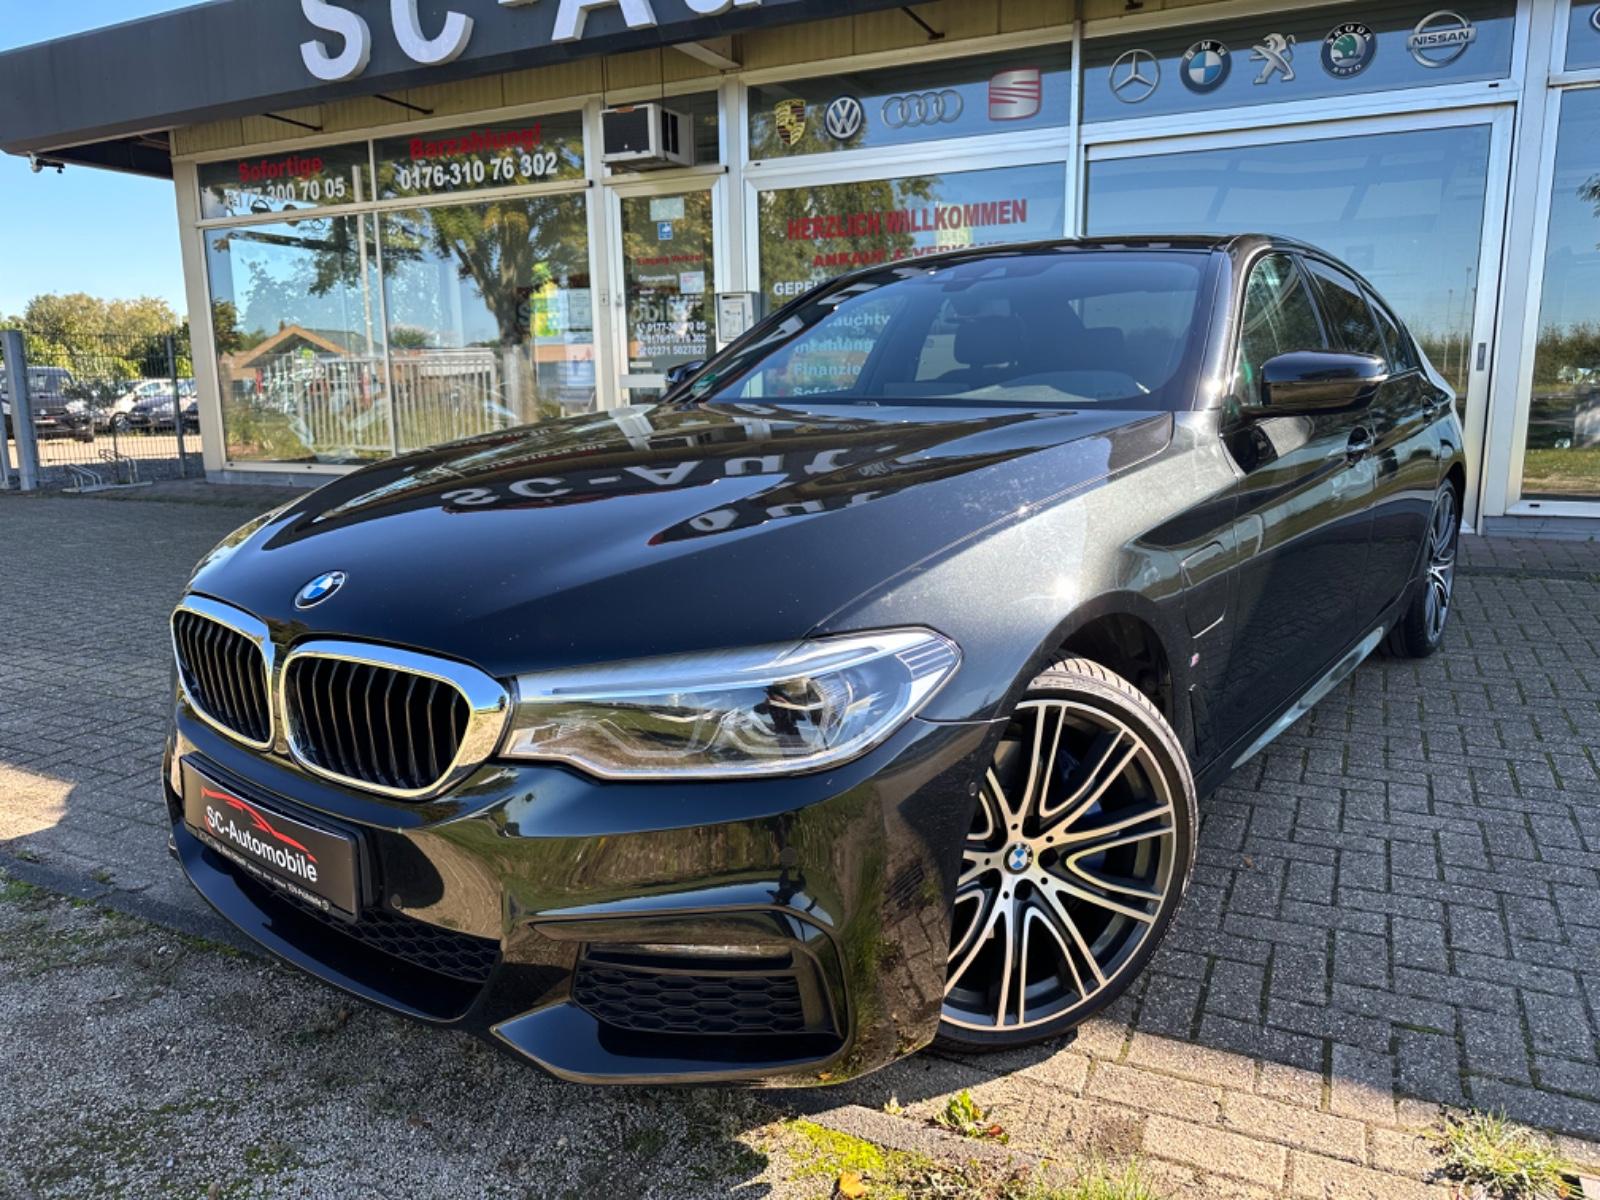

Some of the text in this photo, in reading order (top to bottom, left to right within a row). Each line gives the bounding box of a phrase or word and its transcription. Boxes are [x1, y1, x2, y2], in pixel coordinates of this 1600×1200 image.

[300, 0, 763, 81] SC-A
[1184, 41, 1228, 60] BMW
[1411, 30, 1474, 47] NISSAN
[409, 121, 542, 160] Barzahlung!
[238, 155, 323, 182] Sofortige
[400, 152, 558, 190] 0176-310 76 302
[302, 179, 320, 200] 70
[325, 176, 345, 198] 05
[787, 199, 1028, 241] HERZLICH WILLKOMMEN
[813, 248, 887, 268] ANKAUF
[205, 804, 319, 883] SC-Automobile
